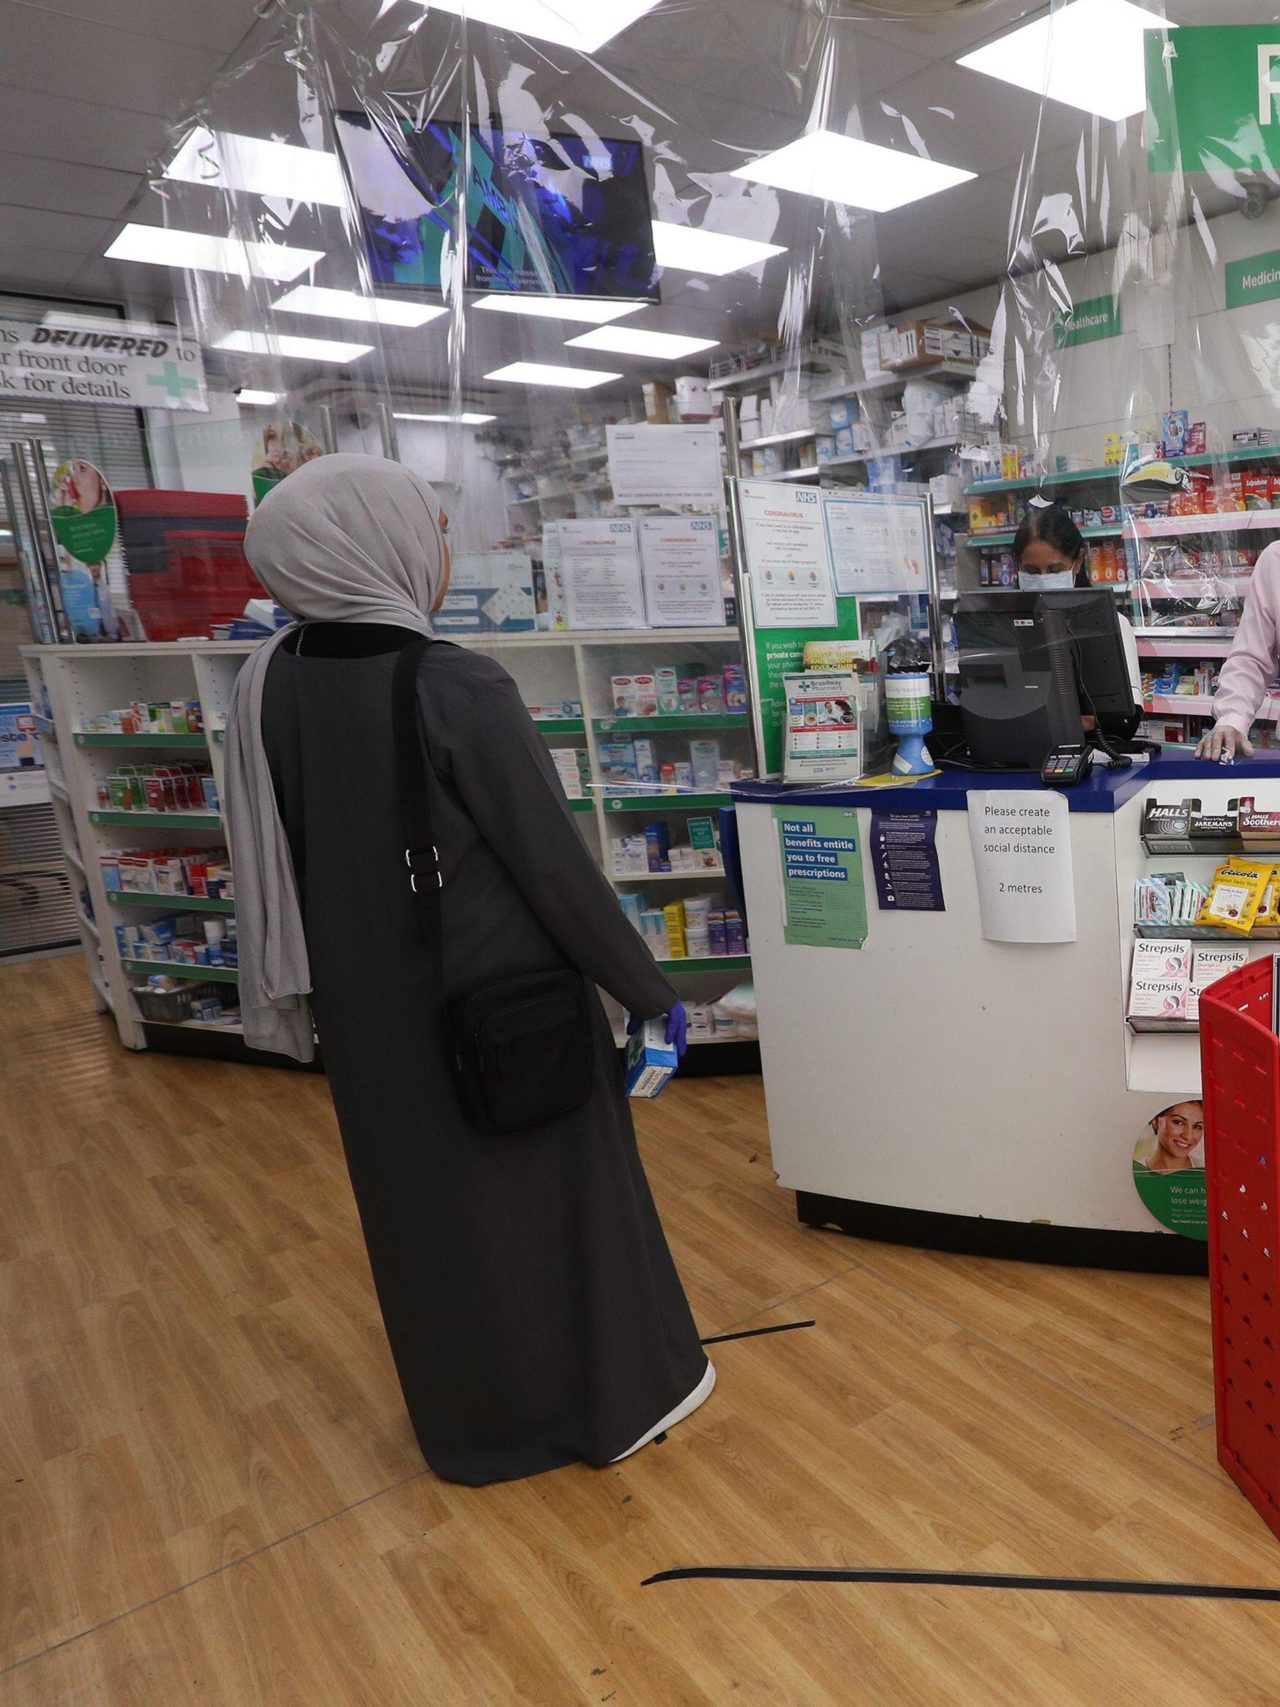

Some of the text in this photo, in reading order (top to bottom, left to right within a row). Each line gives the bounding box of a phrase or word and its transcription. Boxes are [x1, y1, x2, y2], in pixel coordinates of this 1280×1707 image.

[31, 327, 195, 363] DELIVERED to
[18, 350, 127, 376] front door
[23, 372, 130, 398] for details
[797, 492, 817, 503] NHS
[763, 510, 803, 519] CORONAVIRUS
[610, 524, 631, 532] NHS
[691, 521, 712, 530] NHS
[767, 652, 789, 661] private
[984, 806, 1050, 817] Please create
[1149, 808, 1189, 819] HALLS
[784, 823, 813, 832] Not all
[1194, 820, 1233, 828] JAKEMANS
[984, 825, 1053, 836] an acceptable
[785, 838, 853, 849] benefits entitle
[984, 843, 1055, 853] social distance
[786, 853, 835, 863] you to free
[788, 868, 846, 878] prescriptions
[999, 883, 1043, 894] 2 metres
[1138, 943, 1185, 955] Strepsils
[1197, 952, 1244, 963] Strepsils
[1135, 980, 1183, 992] Strepsils
[1170, 1186, 1183, 1194] We
[1171, 1197, 1187, 1205] lose
